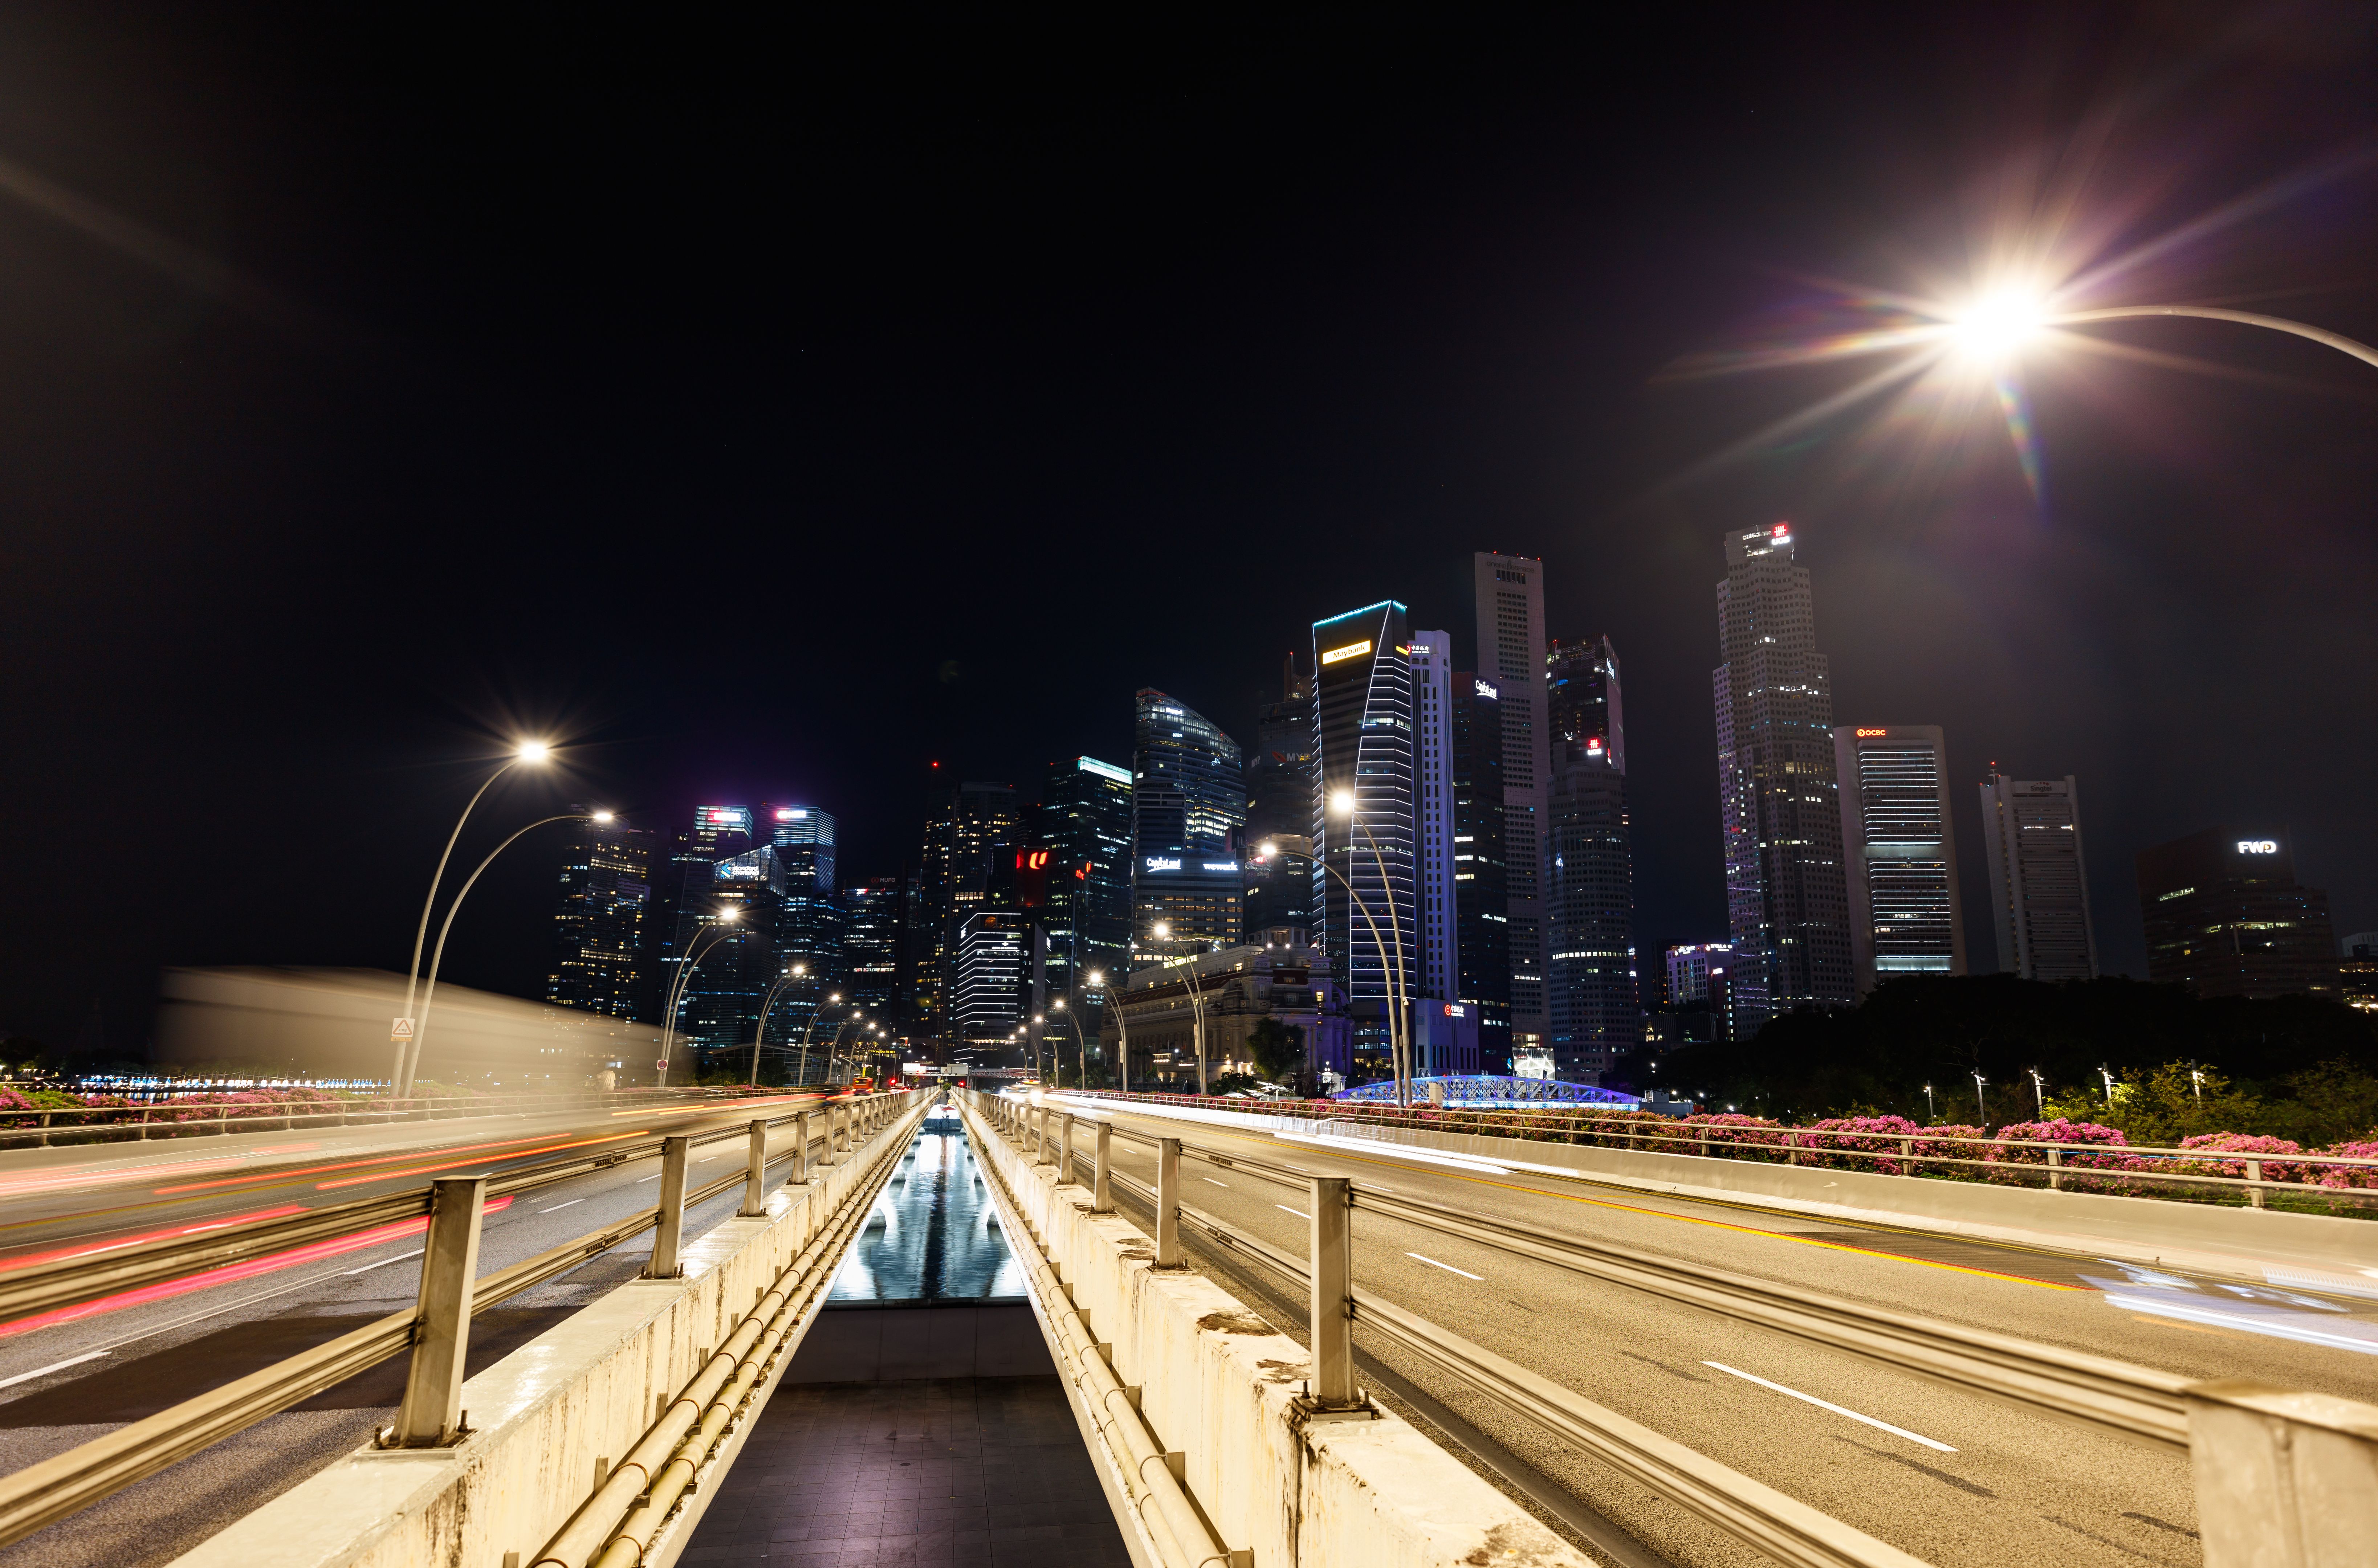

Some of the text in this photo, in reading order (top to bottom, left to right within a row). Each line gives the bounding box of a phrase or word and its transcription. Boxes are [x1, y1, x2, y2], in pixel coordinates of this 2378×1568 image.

[1772, 536, 1790, 545] UOB
[1333, 645, 1365, 658] Maybank
[1251, 756, 1261, 768] MYP
[2238, 841, 2276, 853] FWD
